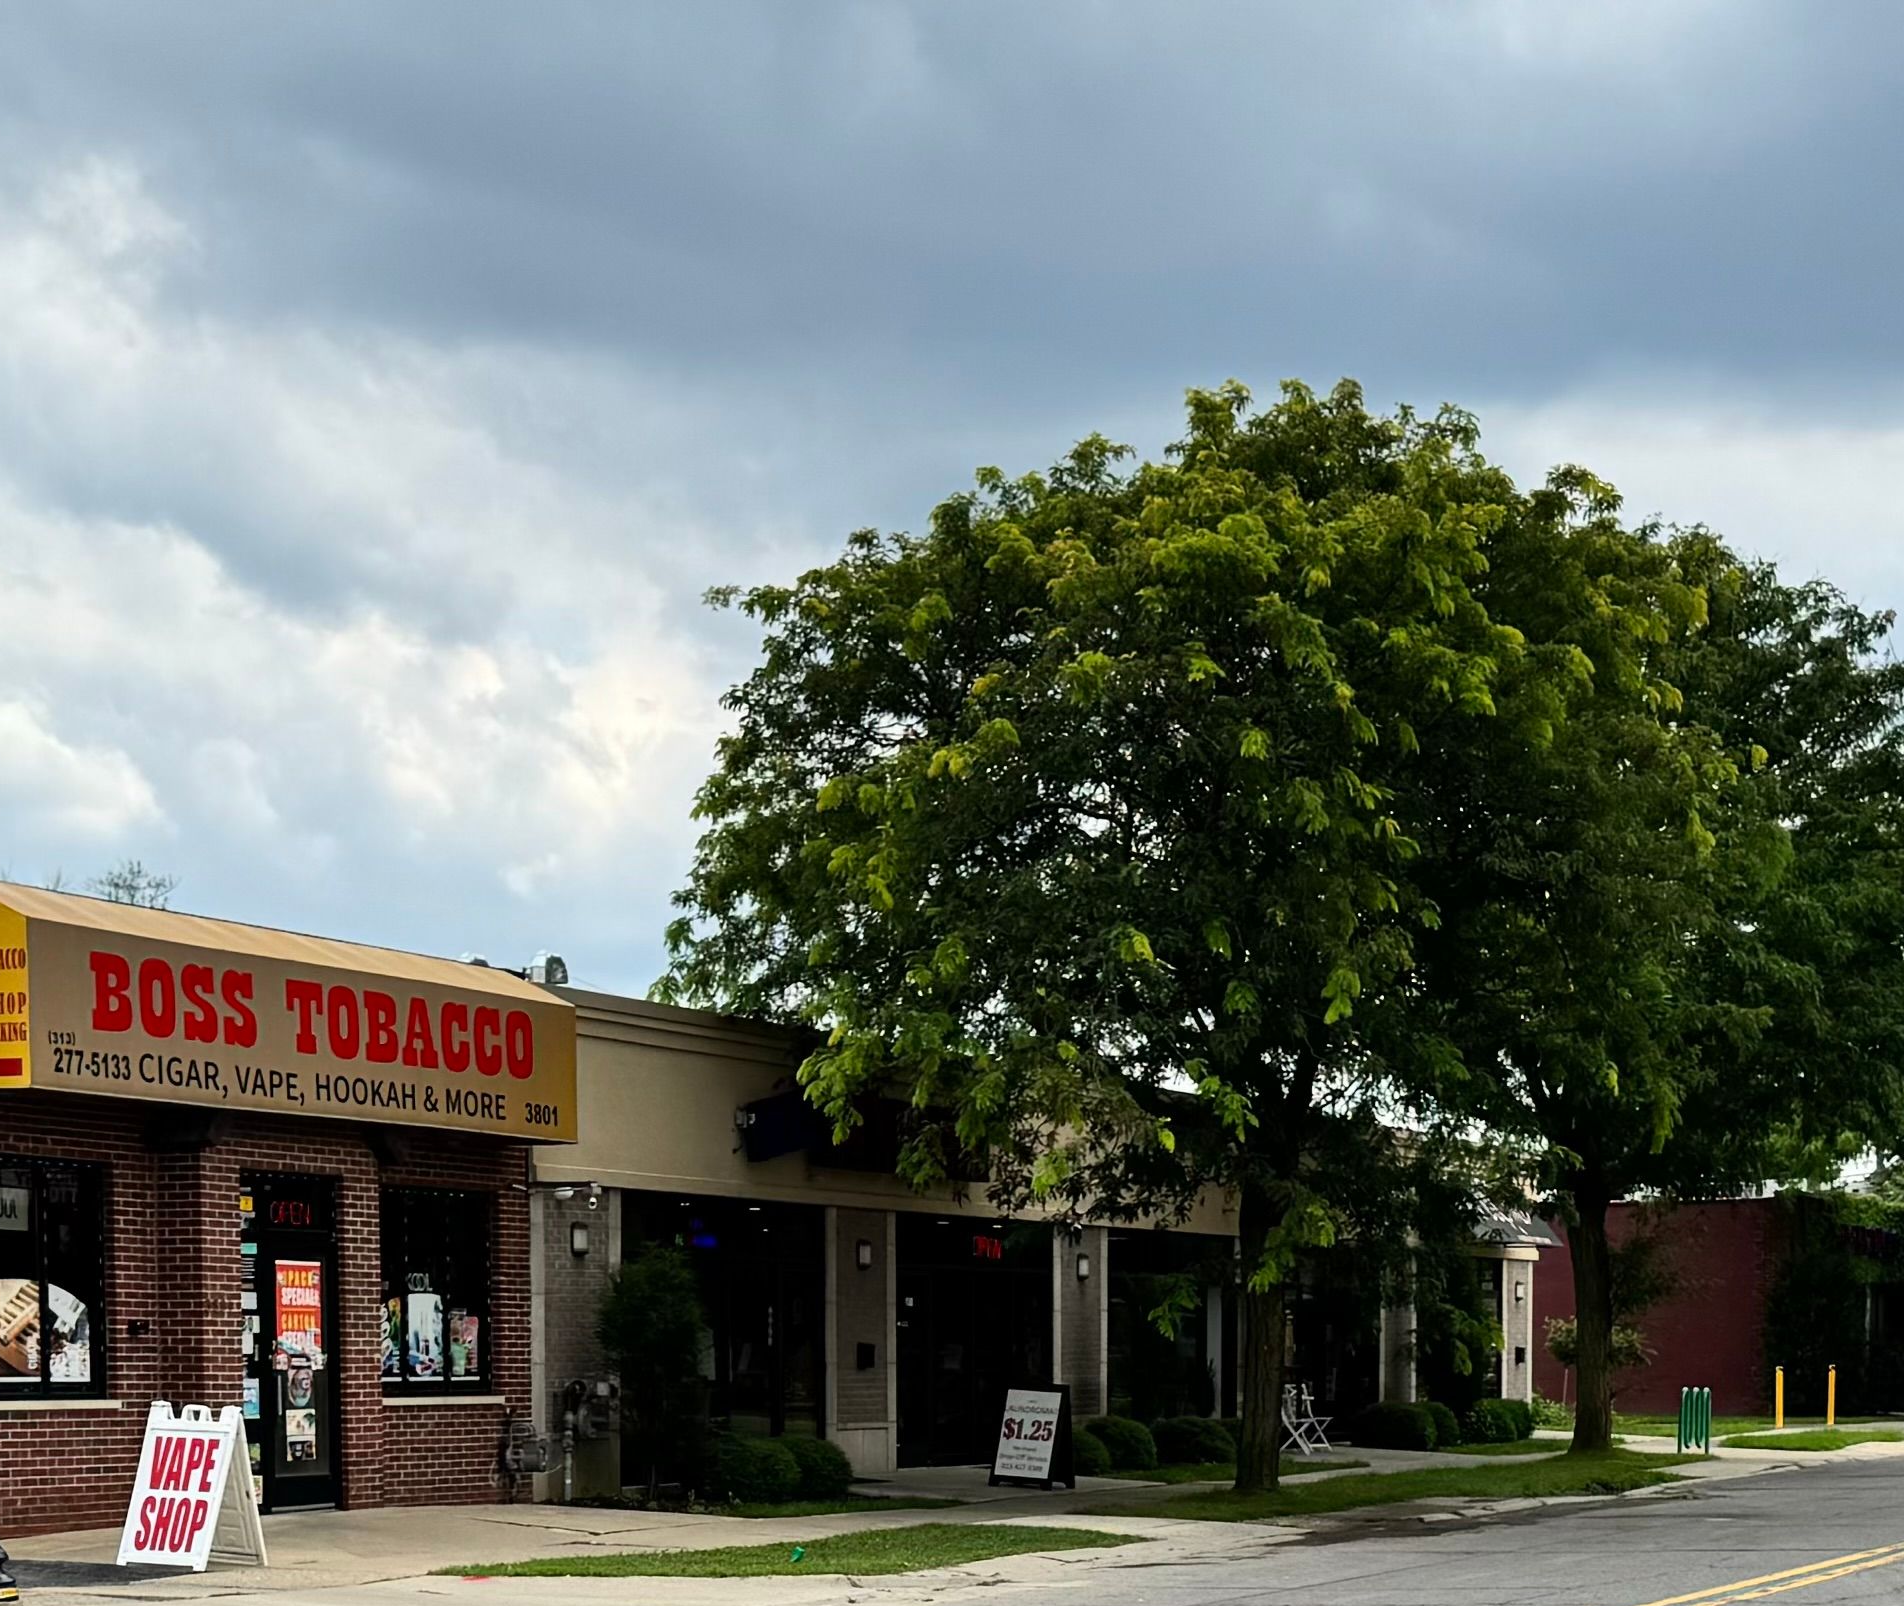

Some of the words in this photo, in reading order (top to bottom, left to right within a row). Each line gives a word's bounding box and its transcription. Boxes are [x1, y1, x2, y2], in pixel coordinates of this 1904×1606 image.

[48, 1030, 76, 1046] (313)
[89, 950, 257, 1048] BOSS
[285, 978, 534, 1080] TOBACCO
[53, 1047, 131, 1080] 277-5133
[138, 1053, 228, 1098] CIGAR,
[235, 1064, 305, 1106] VAPE,
[315, 1072, 416, 1110] HOOKAH
[424, 1086, 439, 1113] &
[446, 1088, 507, 1120] MORE
[525, 1102, 558, 1127] 3801
[1003, 1417, 1054, 1441] $1.25
[149, 1436, 220, 1492] VAPE
[134, 1495, 209, 1553] SHOP
